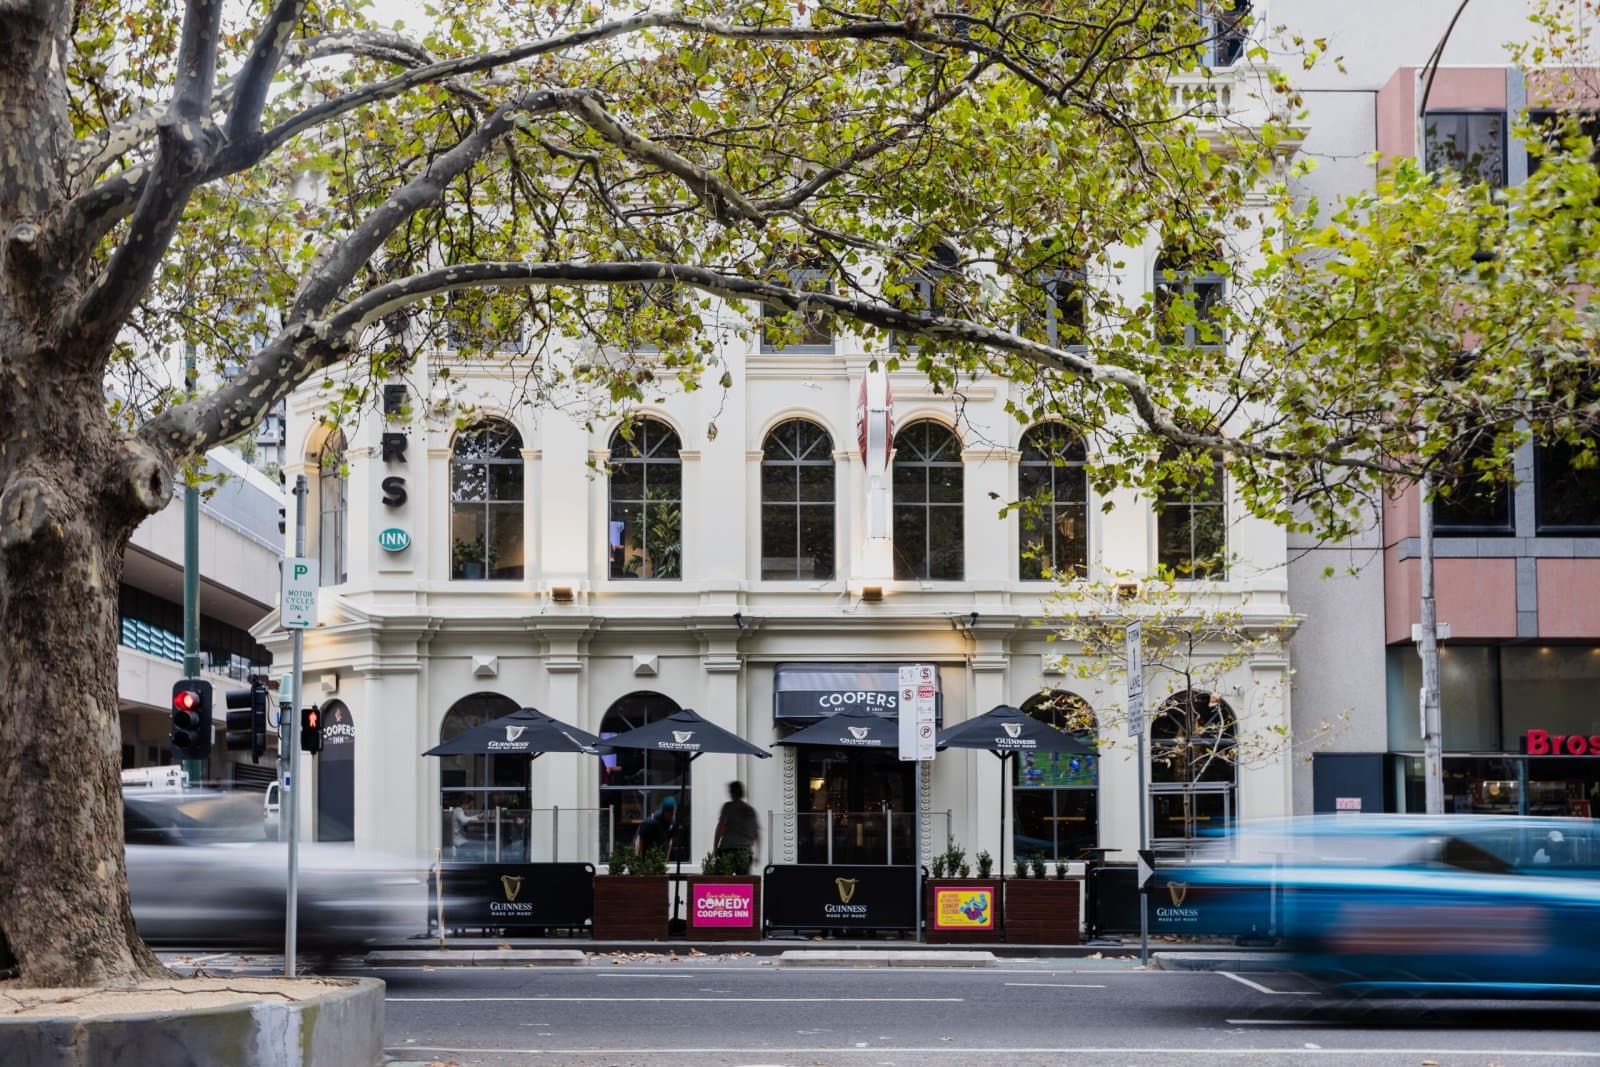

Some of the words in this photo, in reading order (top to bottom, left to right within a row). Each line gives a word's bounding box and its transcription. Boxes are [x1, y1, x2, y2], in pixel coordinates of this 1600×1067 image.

[380, 533, 407, 545] INN
[294, 564, 308, 580] P
[288, 590, 313, 598] MOTOR
[819, 692, 896, 708] COOPERS
[332, 736, 345, 745] INN
[490, 901, 533, 911] GUINNESS
[697, 897, 750, 910] COMEDY
[824, 903, 868, 913] GUINNESS
[697, 910, 734, 918] COOPERS
[734, 910, 749, 918] INN
[1156, 907, 1199, 917] GUINNESS
